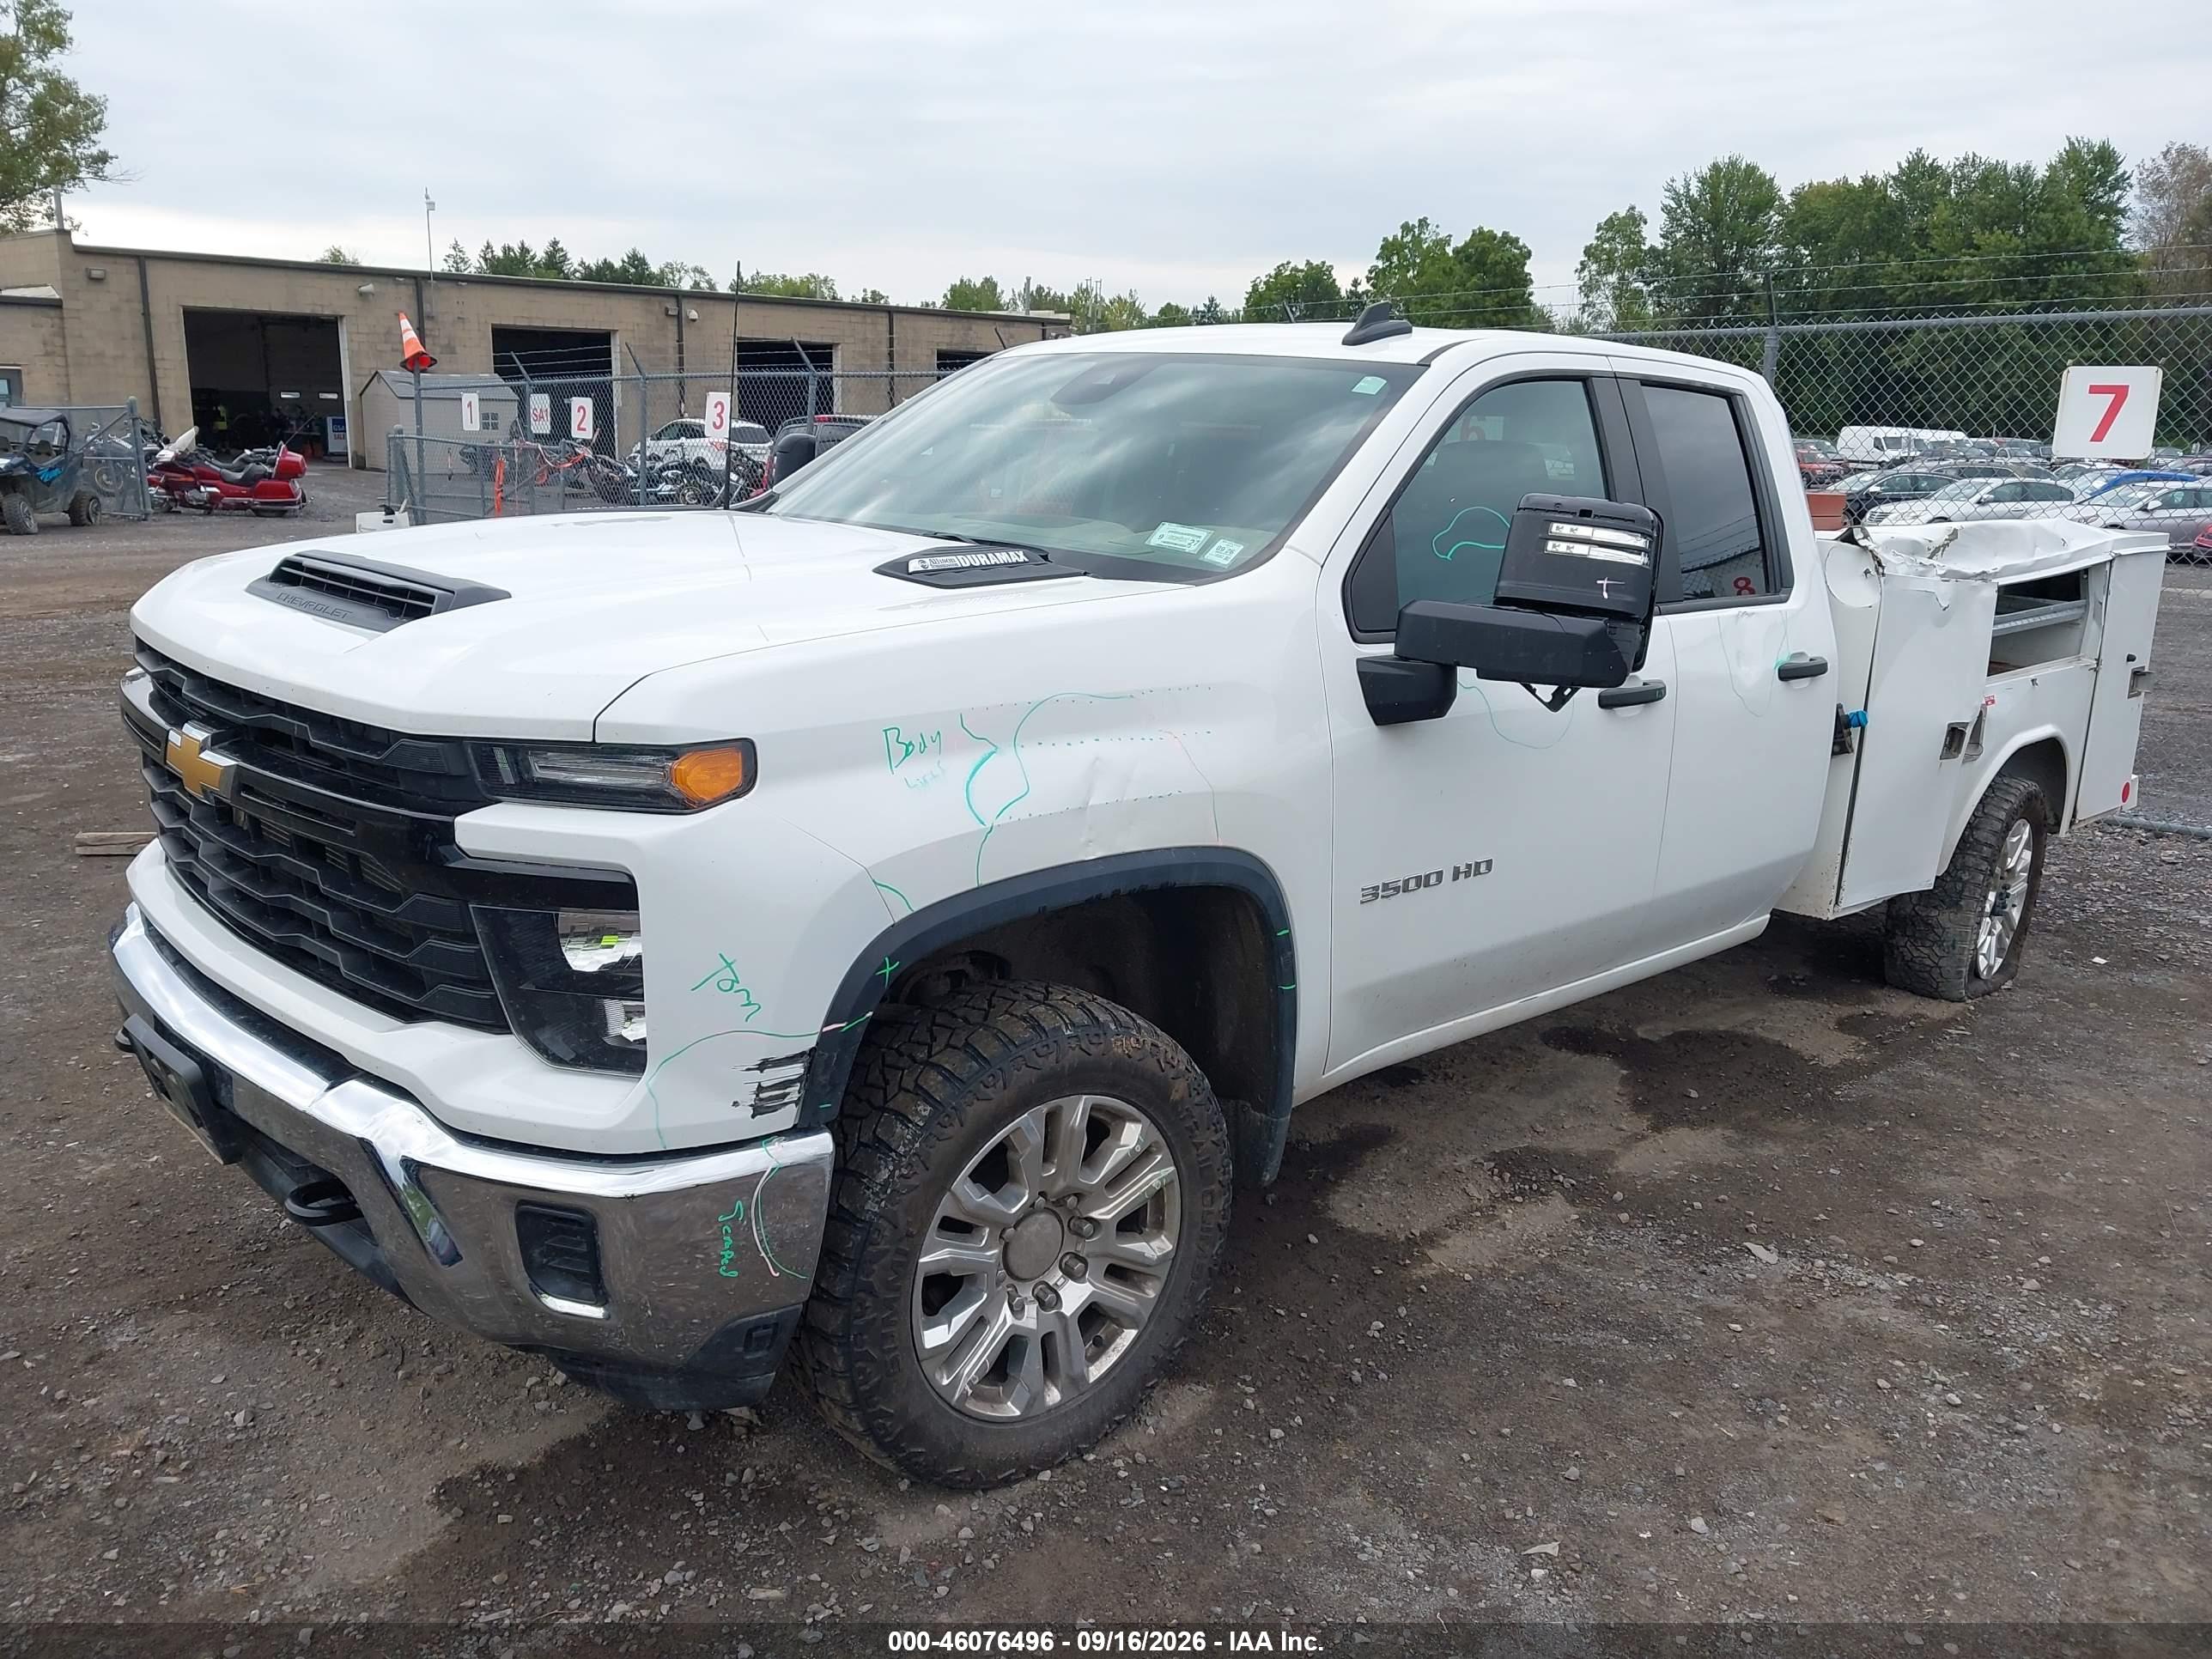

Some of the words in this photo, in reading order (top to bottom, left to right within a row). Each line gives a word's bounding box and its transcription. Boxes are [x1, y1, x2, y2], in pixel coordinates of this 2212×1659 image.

[466, 400, 474, 424] 1
[532, 410, 550, 422] SA1
[576, 404, 587, 432] 2
[712, 400, 726, 430] 3
[2087, 384, 2130, 443] 7
[929, 556, 957, 565] Allison
[957, 550, 1030, 568] DURAMAX
[276, 592, 354, 619] CHEVROLET
[882, 726, 941, 775] Body
[1359, 868, 1444, 905] 3500
[1452, 858, 1493, 882] HD
